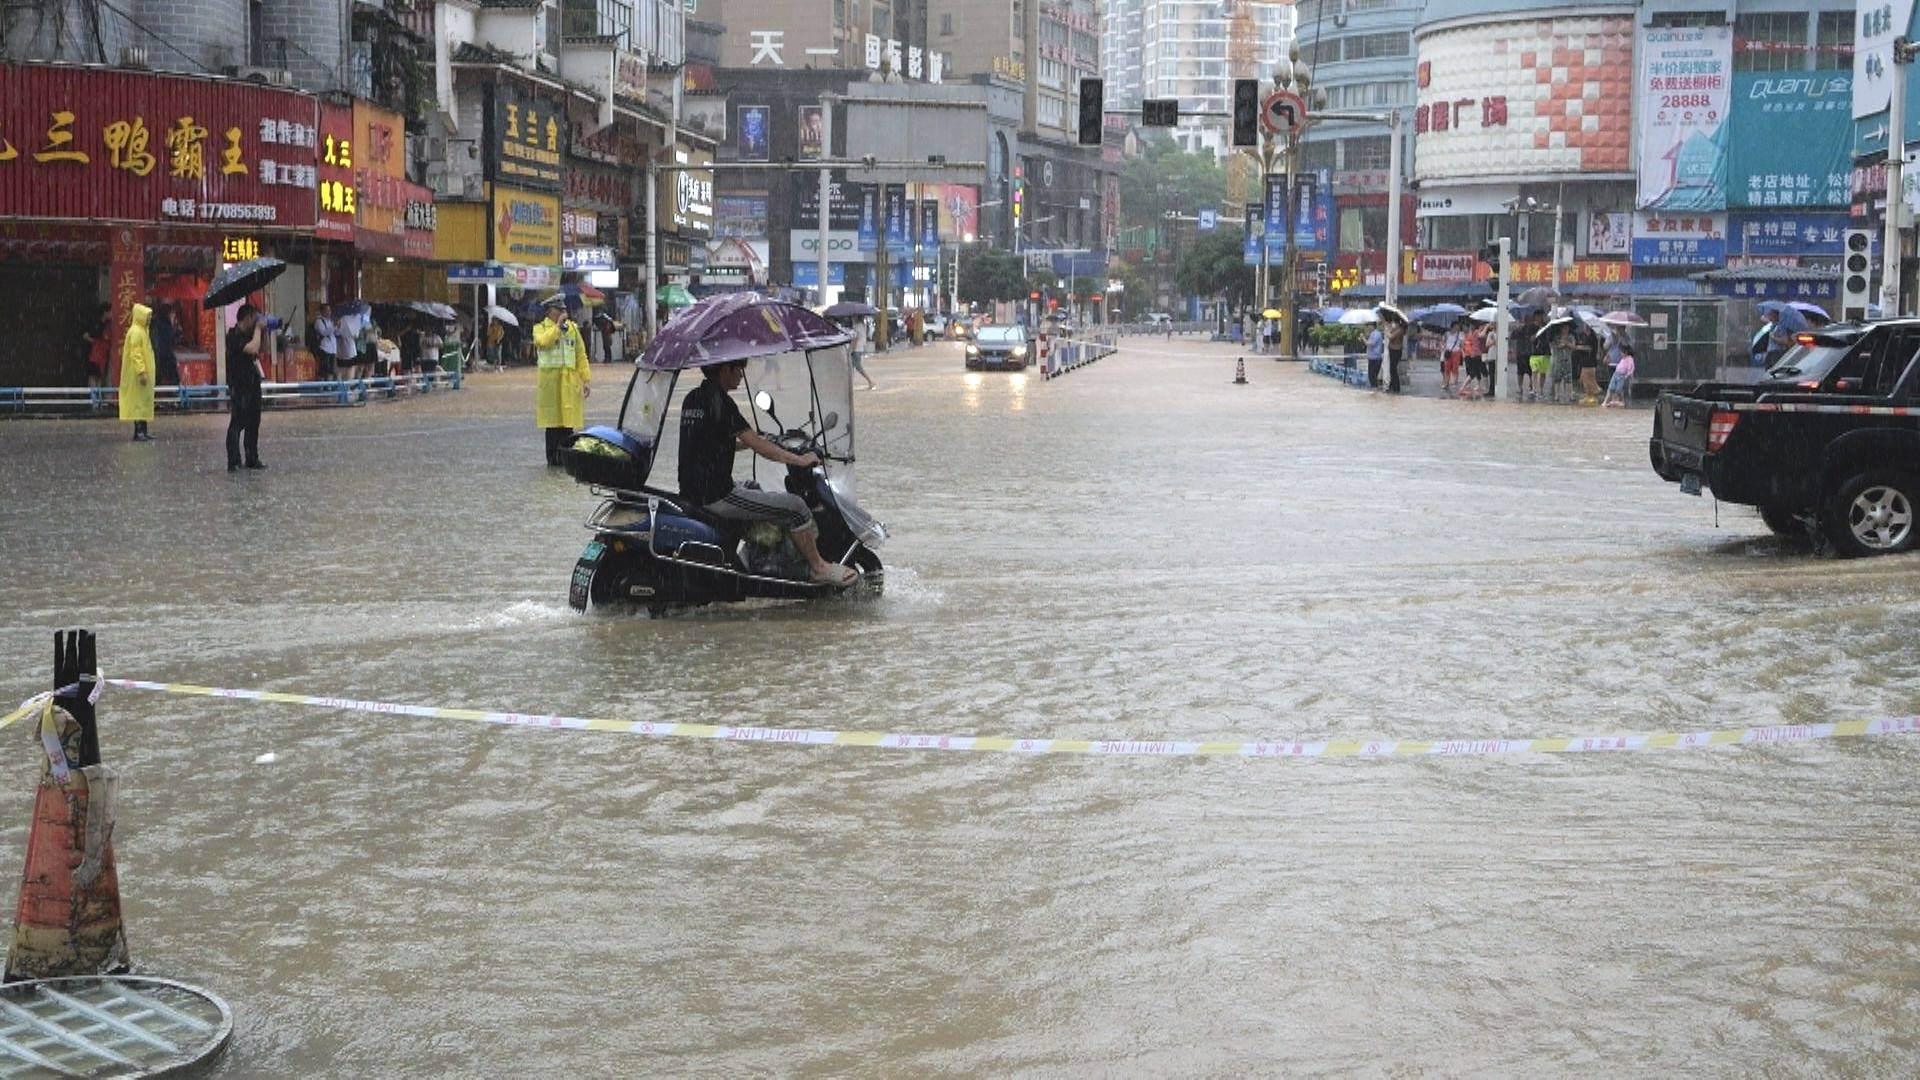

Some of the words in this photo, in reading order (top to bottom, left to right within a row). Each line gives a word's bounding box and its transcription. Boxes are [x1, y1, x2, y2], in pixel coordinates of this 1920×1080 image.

[750, 30, 838, 64] 天一
[324, 134, 352, 168] 九三
[162, 197, 195, 217] 电话
[200, 203, 277, 220] 17708563893
[577, 247, 613, 265] 停车场
